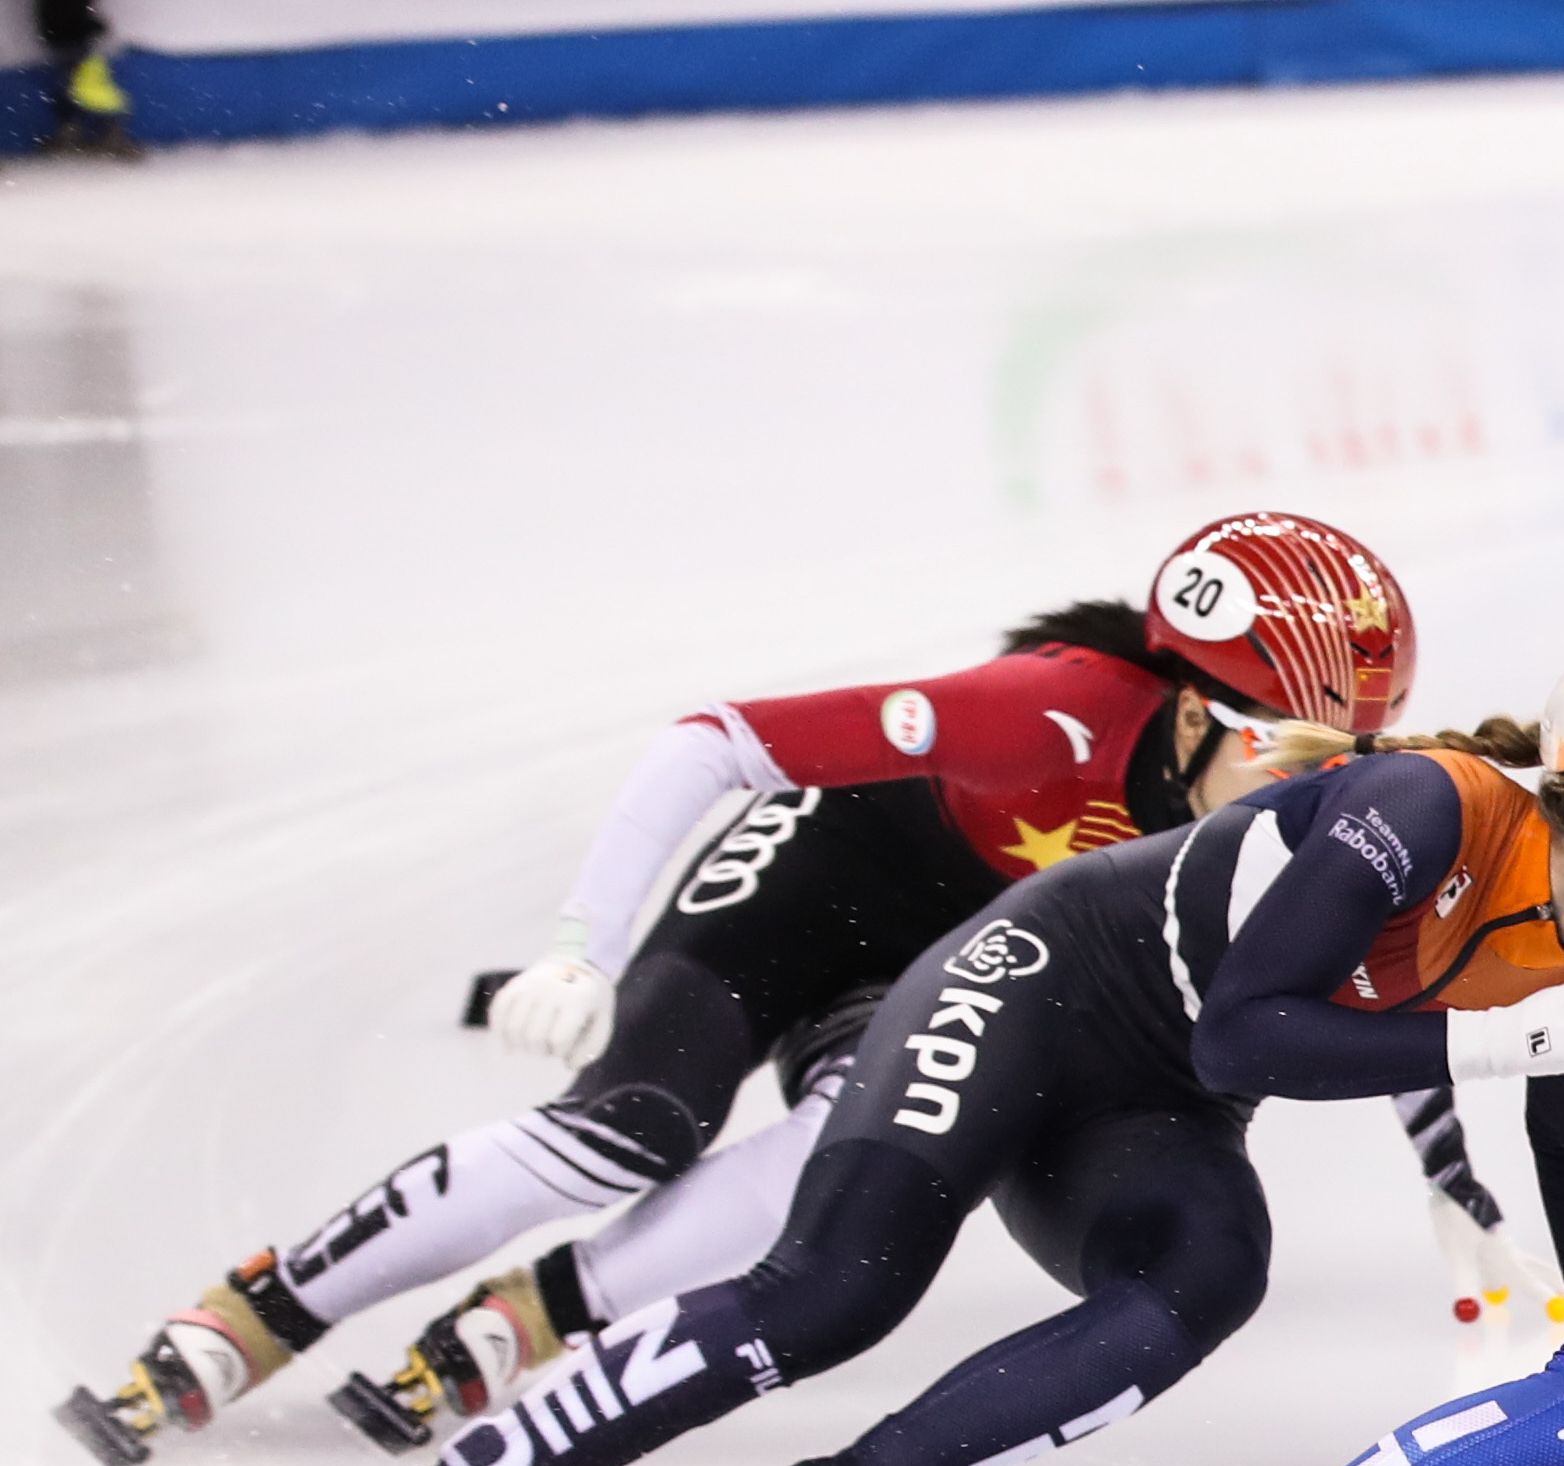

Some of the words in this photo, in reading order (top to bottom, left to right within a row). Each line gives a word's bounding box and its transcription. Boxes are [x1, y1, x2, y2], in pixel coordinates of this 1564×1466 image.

[1173, 566, 1224, 617] 20
[1366, 806, 1413, 877] TeamNL
[893, 987, 1004, 1135] kpn
